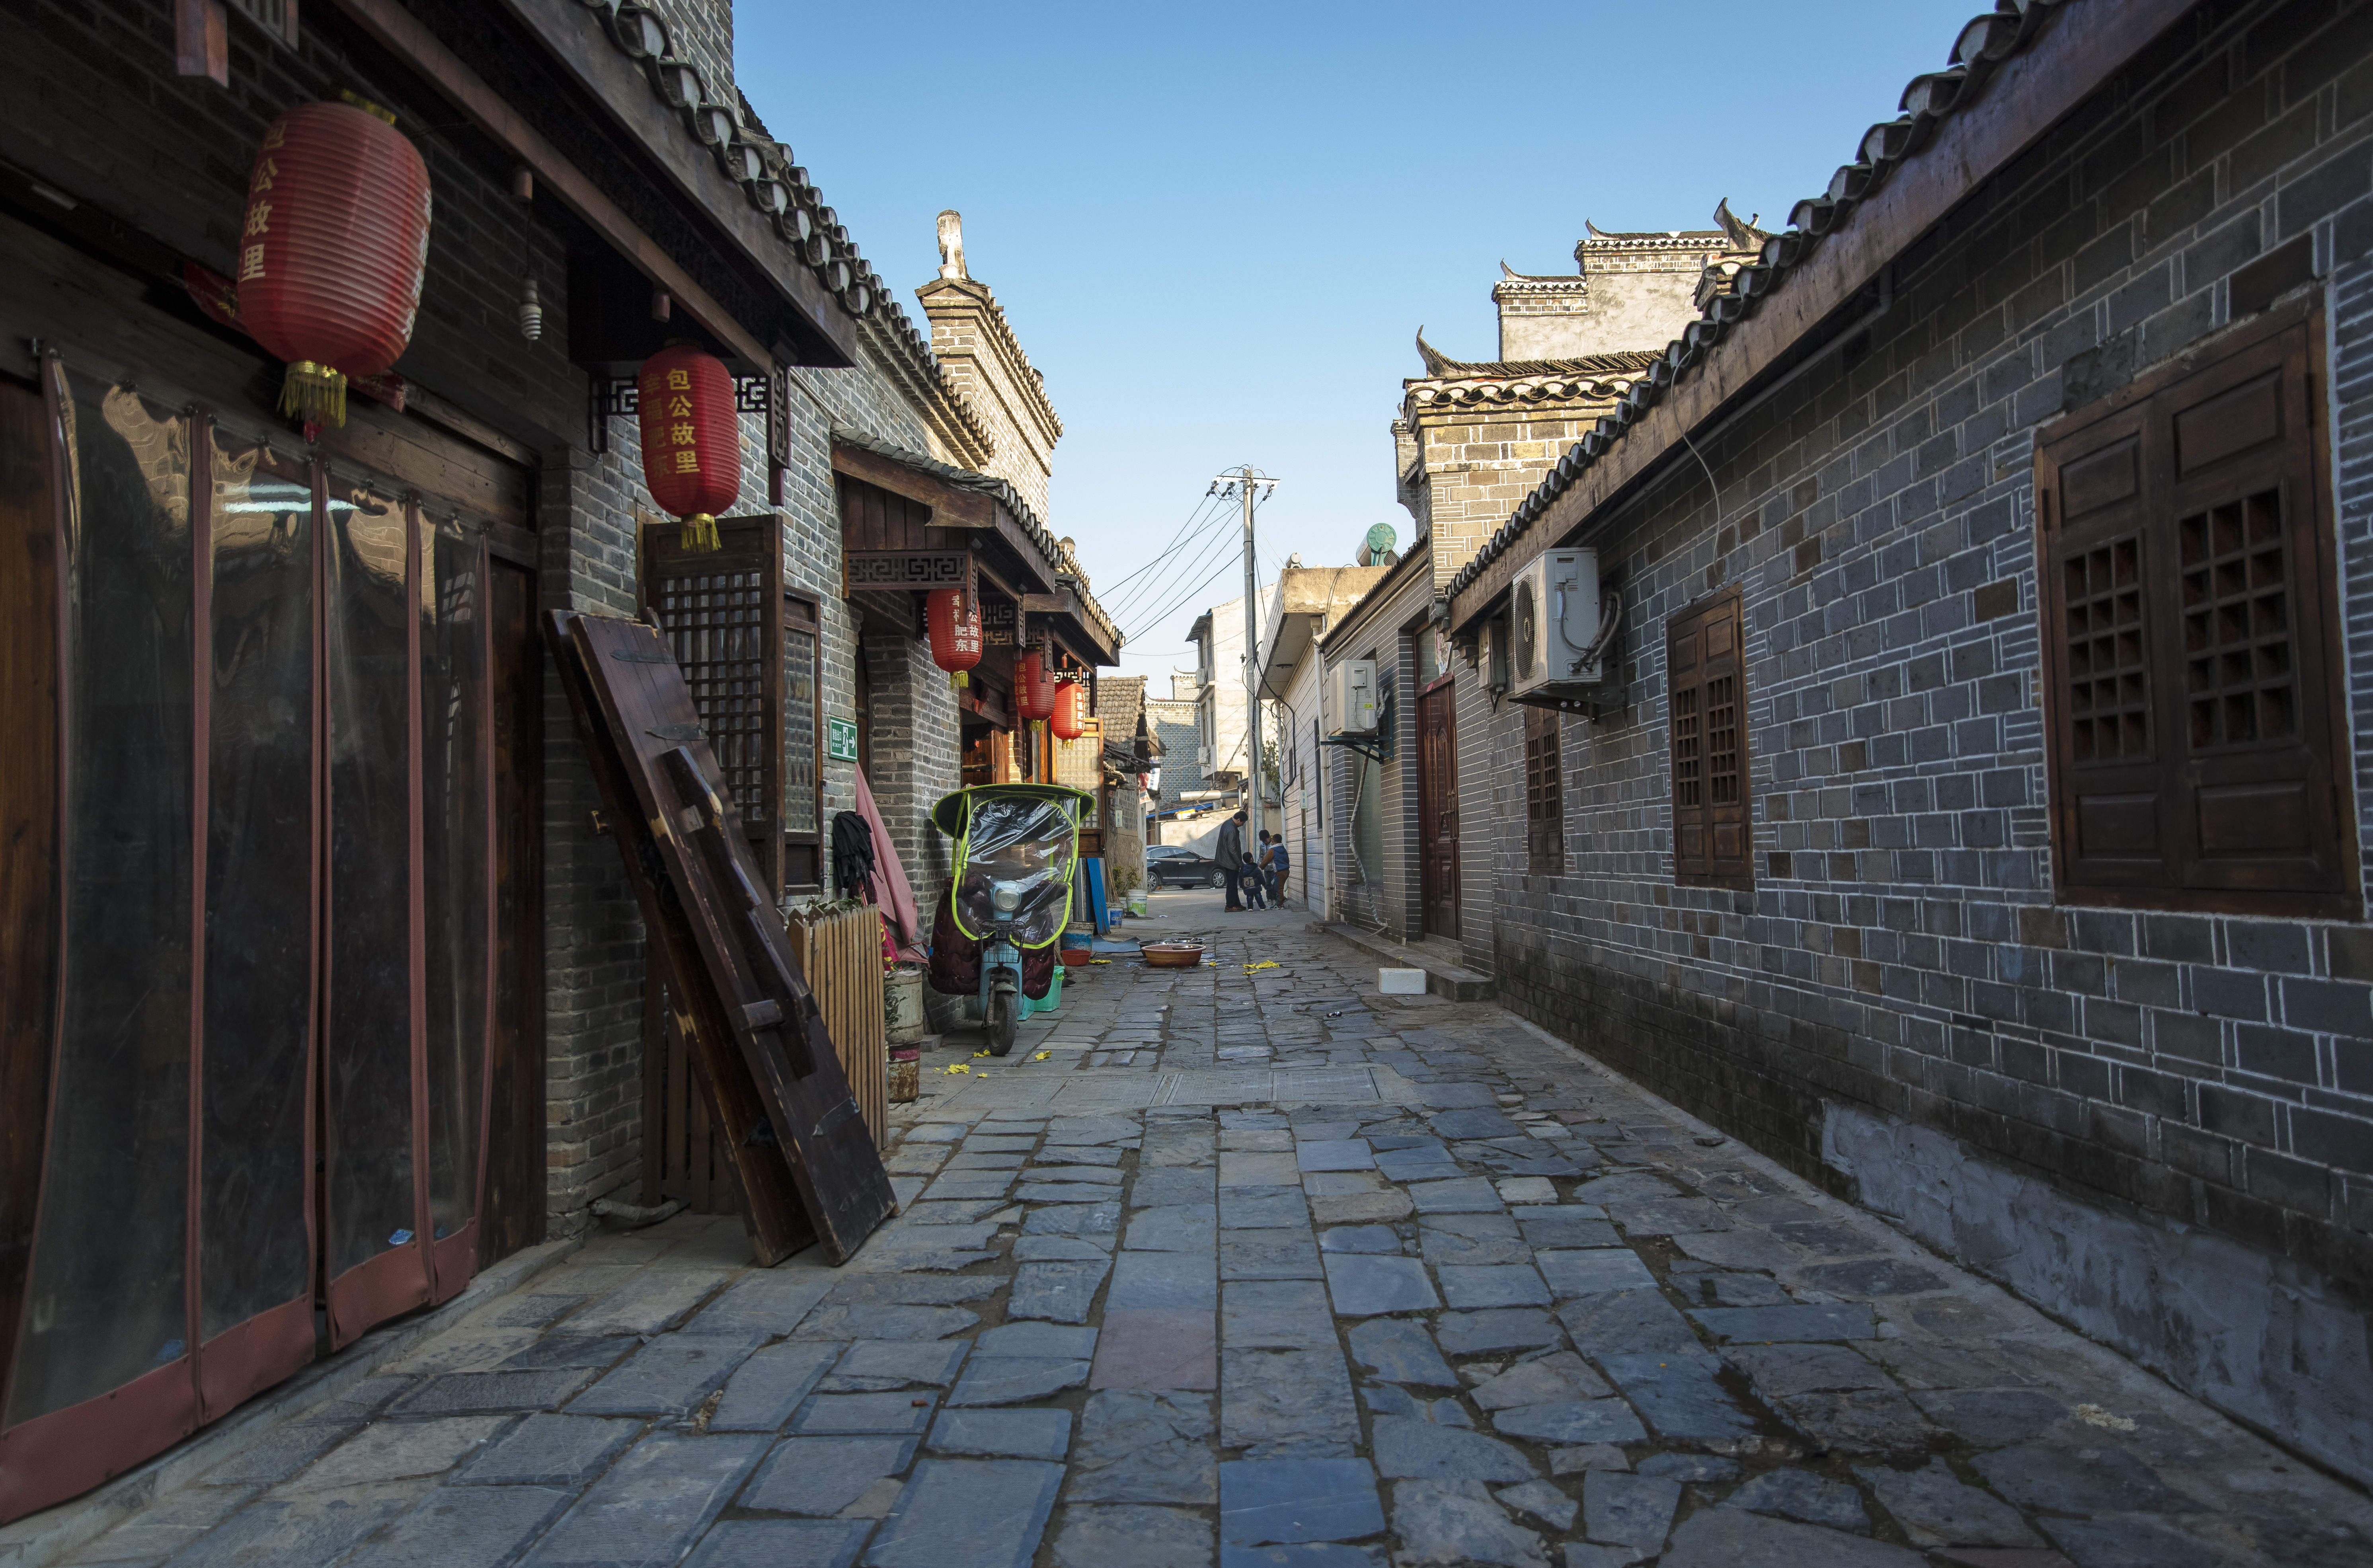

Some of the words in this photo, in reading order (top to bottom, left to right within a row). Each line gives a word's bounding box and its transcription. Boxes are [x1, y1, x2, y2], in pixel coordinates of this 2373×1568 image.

[667, 368, 700, 473] 包公故里
[969, 612, 979, 653] 公故里
[1019, 663, 1029, 706] 包公故里
